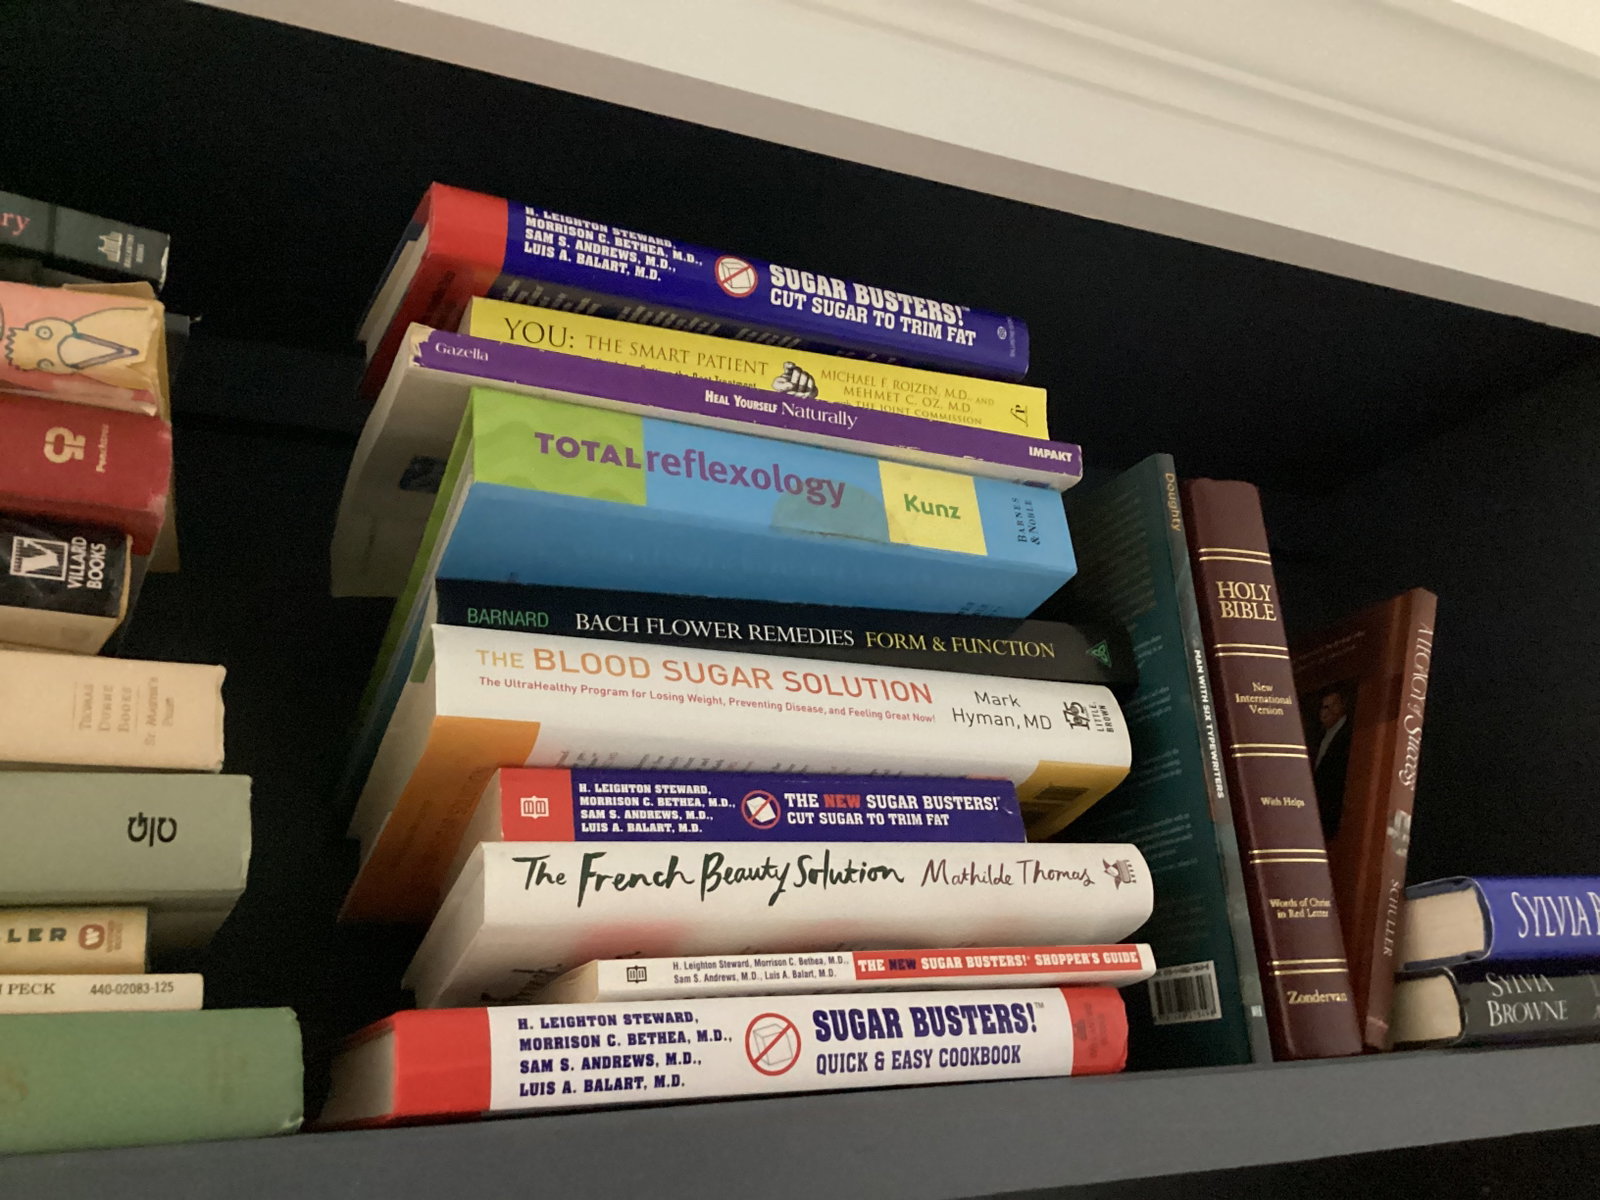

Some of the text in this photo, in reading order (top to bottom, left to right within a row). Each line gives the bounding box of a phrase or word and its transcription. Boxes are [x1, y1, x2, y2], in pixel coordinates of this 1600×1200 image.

[769, 263, 848, 301] SUGAR
[770, 287, 977, 347] CUT SUGAR TO TRIM FAT
[434, 341, 489, 362] Gazella
[504, 317, 575, 349] YOU:
[586, 334, 622, 354] THE
[630, 341, 691, 365] SMART
[696, 352, 769, 376] PATIENT
[821, 369, 877, 387] MICHAEL
[975, 397, 995, 406] AND
[843, 386, 900, 403] MEHMET
[781, 400, 858, 430] Naturally
[879, 404, 910, 416] JOINT
[914, 408, 982, 425] COMMISSION
[1029, 446, 1072, 463] IMPAKT
[533, 431, 846, 509] TOTAL reflexology
[903, 491, 962, 521] Kunz
[1165, 472, 1181, 532] Doughty
[1011, 497, 1028, 543] BARNES
[67, 536, 88, 590] VILLARD
[87, 543, 106, 590] BOOKS
[1216, 581, 1271, 601] HOLY
[467, 607, 550, 629] BARNARD
[1220, 601, 1277, 621] BIBLE
[575, 612, 1056, 659] BACH FLOWER REMEDIES FORM & FUNCTION
[1417, 622, 1434, 635] A
[475, 648, 934, 705] THE BLOOD SUGAR SOLUTION
[1252, 682, 1273, 692] New
[479, 676, 936, 724] The UltraHealthy Program for Losing Weight, Preventing Disease, and Feeling Great Now!
[974, 690, 1021, 708] Mark
[1235, 693, 1293, 705] International
[1249, 704, 1284, 716] Version
[952, 707, 1053, 731] Hyman, MD
[1098, 704, 1115, 733] BROWN
[1194, 649, 1225, 799] MAN WITH SIX TYPEWRITERS
[1399, 714, 1423, 791] Success
[579, 783, 712, 795] H. LEIGHTON STEWARD,
[579, 796, 736, 809] MORRISON C. BETHEA, M.D.,
[784, 792, 819, 808] THE
[823, 793, 861, 808] NEW
[866, 793, 919, 809] SUGAR
[1260, 796, 1282, 807] With
[1283, 796, 1305, 809] Helps
[580, 809, 713, 821] SAM S. ANDREWS, M.D.,
[787, 812, 949, 826] CUT SUGAR TO TRIM FAT
[581, 823, 702, 834] LUIS A. BALART, M.D.
[512, 848, 1096, 908] The French Beauty Solution Mathilde Thomas
[1269, 898, 1297, 908] Words
[1299, 897, 1309, 908] of
[1277, 910, 1287, 919] in
[1288, 909, 1305, 918] Red
[1383, 878, 1401, 956] SCHULLER
[1511, 891, 1592, 939] SYLVIA
[857, 958, 885, 973] THE
[889, 957, 917, 971] NEW
[921, 956, 963, 970] SUGAR
[1034, 952, 1101, 967] SHOPPER'S
[1103, 951, 1139, 964] GUIDE
[8, 983, 56, 996] PECK
[90, 981, 175, 995] 440-02083-125
[1485, 972, 1555, 997] SYLVIA
[1286, 989, 1347, 1005] Zondervan
[518, 1011, 699, 1030] H. LEIGHTON STEWARD,
[812, 1007, 904, 1042] SUGAR
[1486, 1000, 1569, 1027] BROWNE
[519, 1029, 732, 1051] MORRISON C. BETHEA, M.D.,
[520, 1051, 702, 1074] SAM S. ANDREWS, M.D.,
[816, 1044, 1021, 1076] QUICK & EASY COOKBOOK
[519, 1074, 685, 1097] LUIS A. BALART, M.D.
